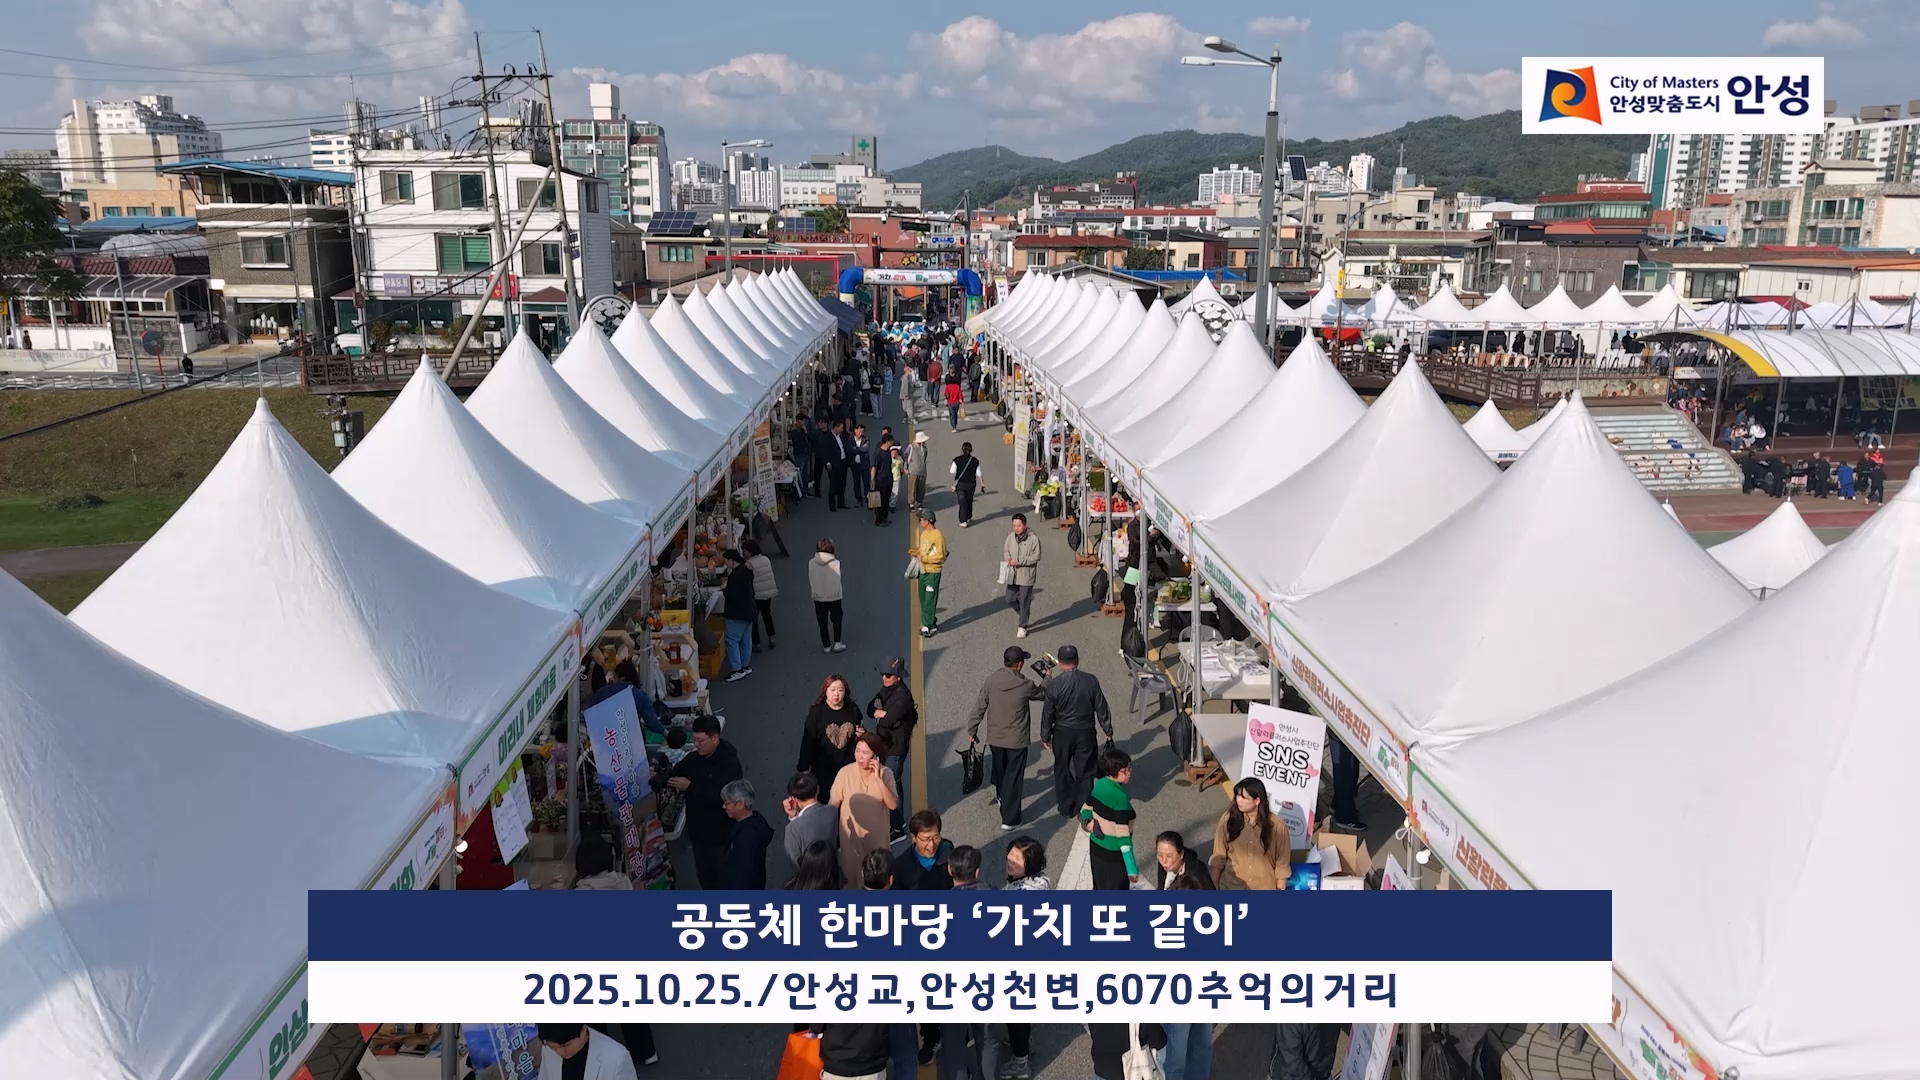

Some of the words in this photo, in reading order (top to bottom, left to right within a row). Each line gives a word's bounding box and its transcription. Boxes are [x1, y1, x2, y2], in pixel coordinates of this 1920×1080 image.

[498, 707, 525, 767] 미리내
[526, 664, 557, 728] 체험마을
[1291, 654, 1371, 748] 신활력플러스사업추진단
[1249, 727, 1320, 751] 신활력플러스사업추진단
[1278, 723, 1299, 735] 안성시
[1258, 741, 1310, 770] SNS
[1253, 761, 1311, 788] EVENT
[603, 725, 645, 877] 농산물판매장
